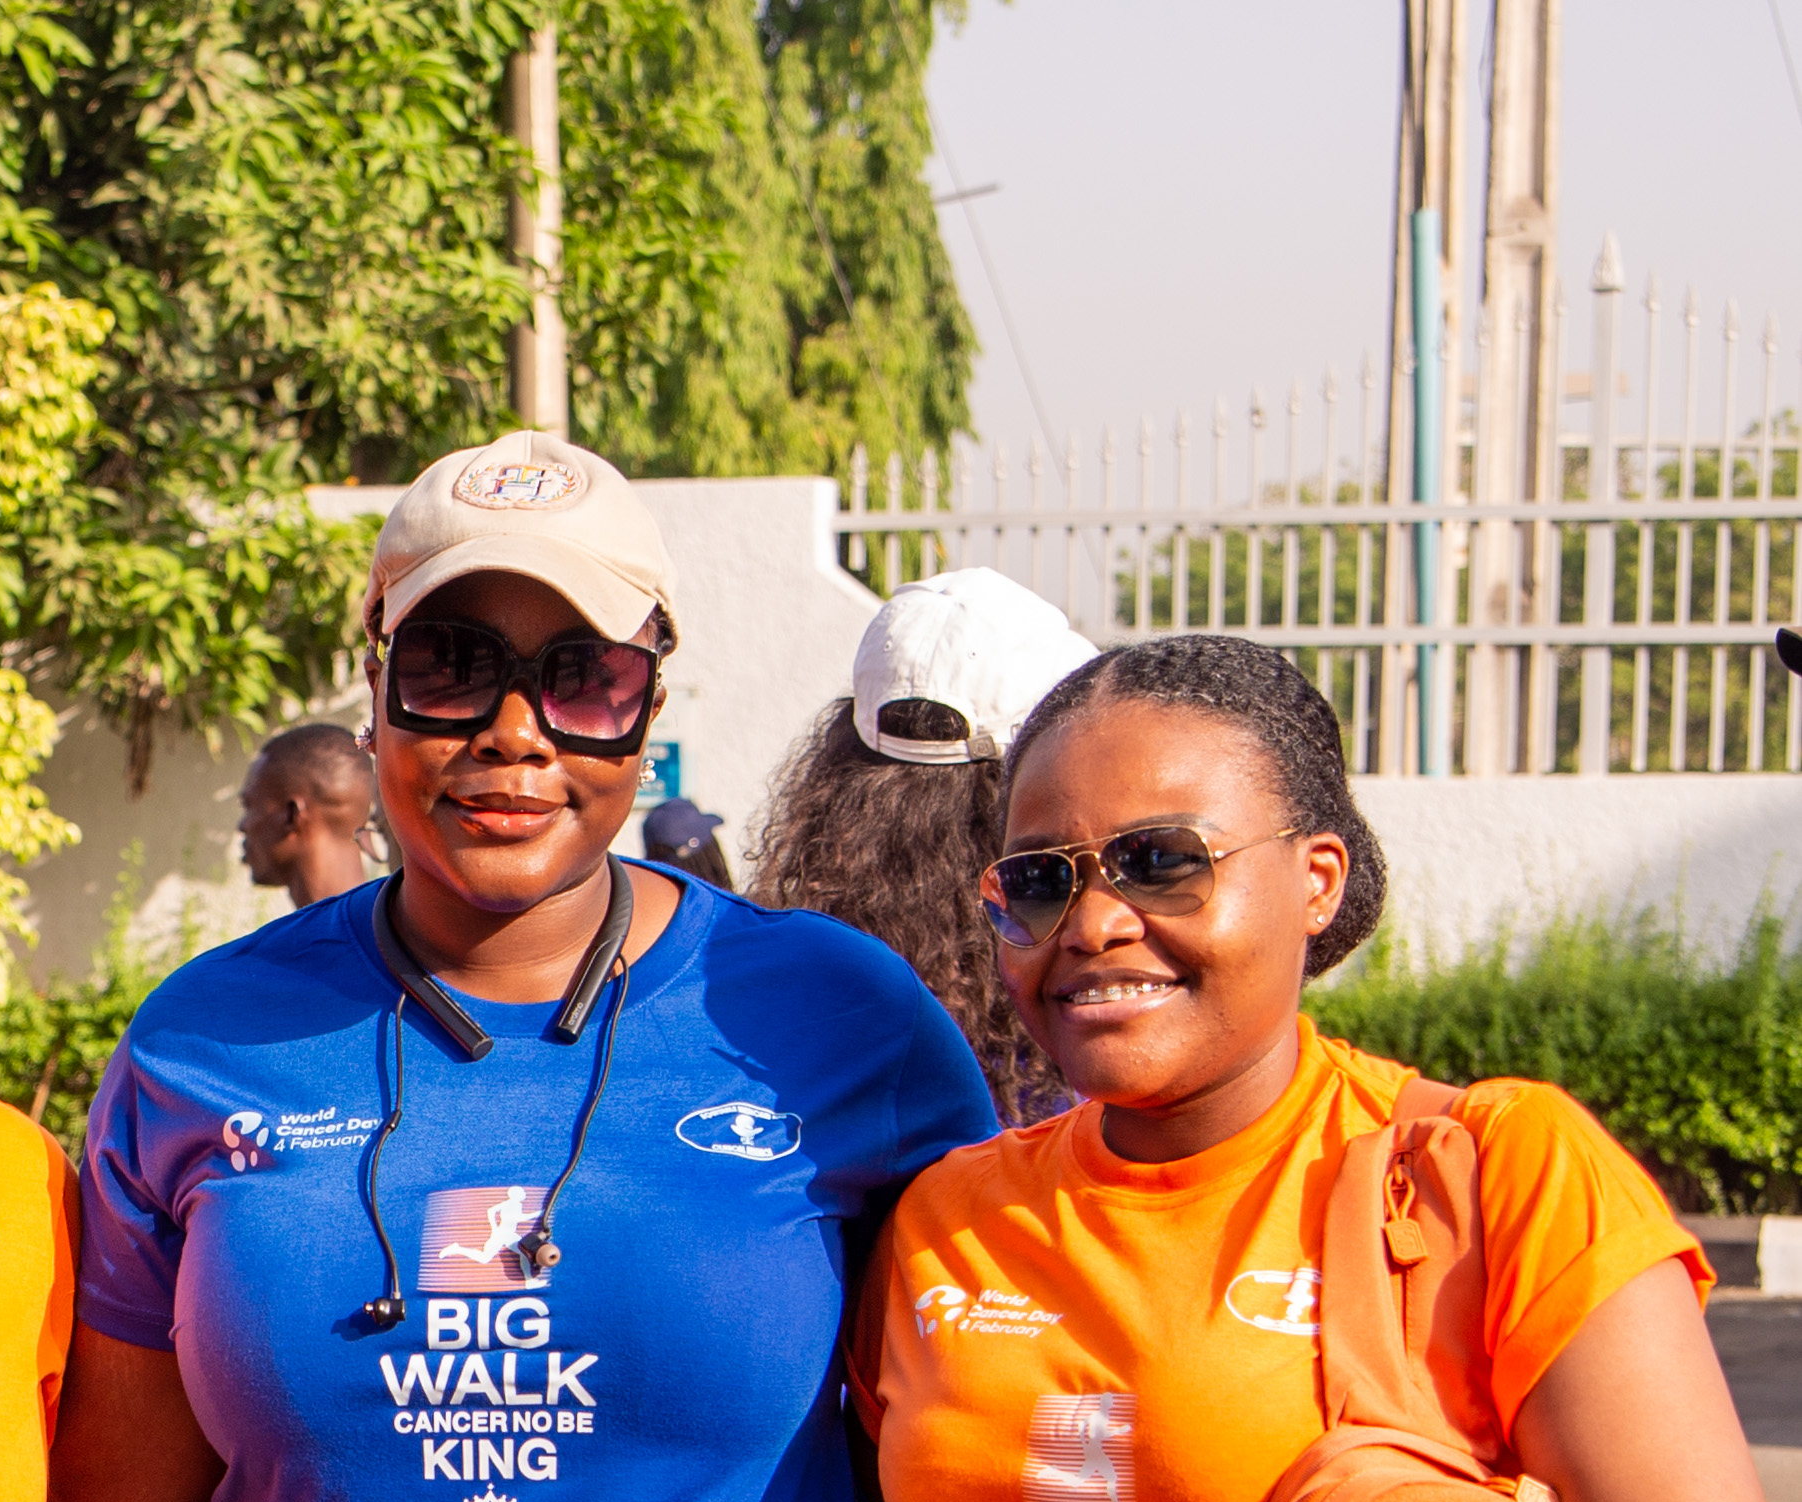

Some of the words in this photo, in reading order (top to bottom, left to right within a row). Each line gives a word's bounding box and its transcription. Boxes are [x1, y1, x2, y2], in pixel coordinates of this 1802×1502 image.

[281, 1107, 335, 1125] World
[276, 1121, 344, 1137] Cancer
[274, 1140, 285, 1152] 4
[290, 1133, 370, 1150] February
[979, 1289, 1030, 1307] World
[427, 1297, 551, 1350] BIG
[967, 1304, 1027, 1321] Cancer
[1027, 1310, 1064, 1325] Day
[958, 1319, 970, 1331] 4
[970, 1321, 1044, 1338] February
[380, 1352, 599, 1406] WALK
[394, 1411, 508, 1434] CANCER
[513, 1410, 553, 1433] NO
[557, 1411, 594, 1434] BE
[423, 1438, 558, 1481] KING
